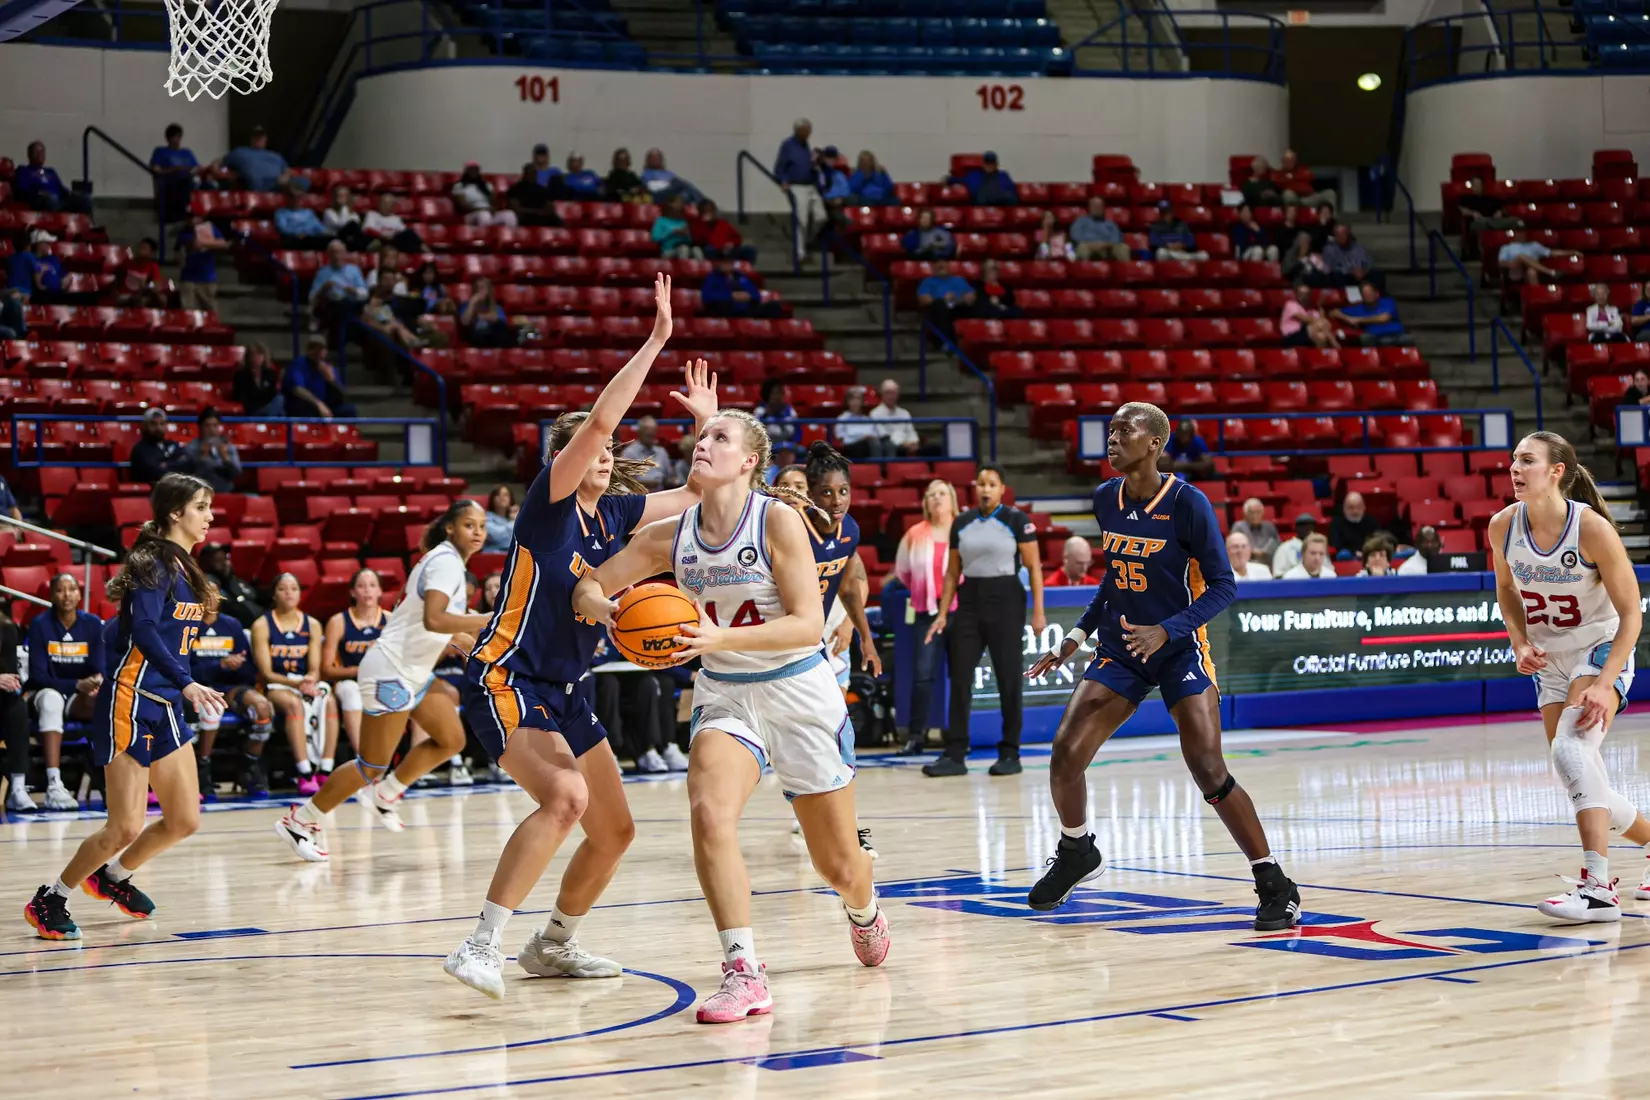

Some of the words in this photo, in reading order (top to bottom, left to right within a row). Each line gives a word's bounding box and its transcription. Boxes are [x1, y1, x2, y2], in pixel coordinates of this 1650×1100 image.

[515, 74, 560, 104] 101
[976, 84, 1025, 111] 102
[1103, 531, 1168, 558] UTEP
[682, 567, 706, 595] Lady
[703, 564, 765, 587] Techsters
[1112, 560, 1148, 592] 35
[172, 601, 205, 620] UTE
[1238, 611, 1281, 632] Your
[1283, 608, 1373, 632] Furniture,
[1374, 605, 1455, 627] Mattress
[1456, 601, 1488, 623] and
[1520, 589, 1582, 627] 23
[1347, 651, 1412, 672] Furniture
[1413, 648, 1465, 669] Partner
[1466, 647, 1483, 666] of
